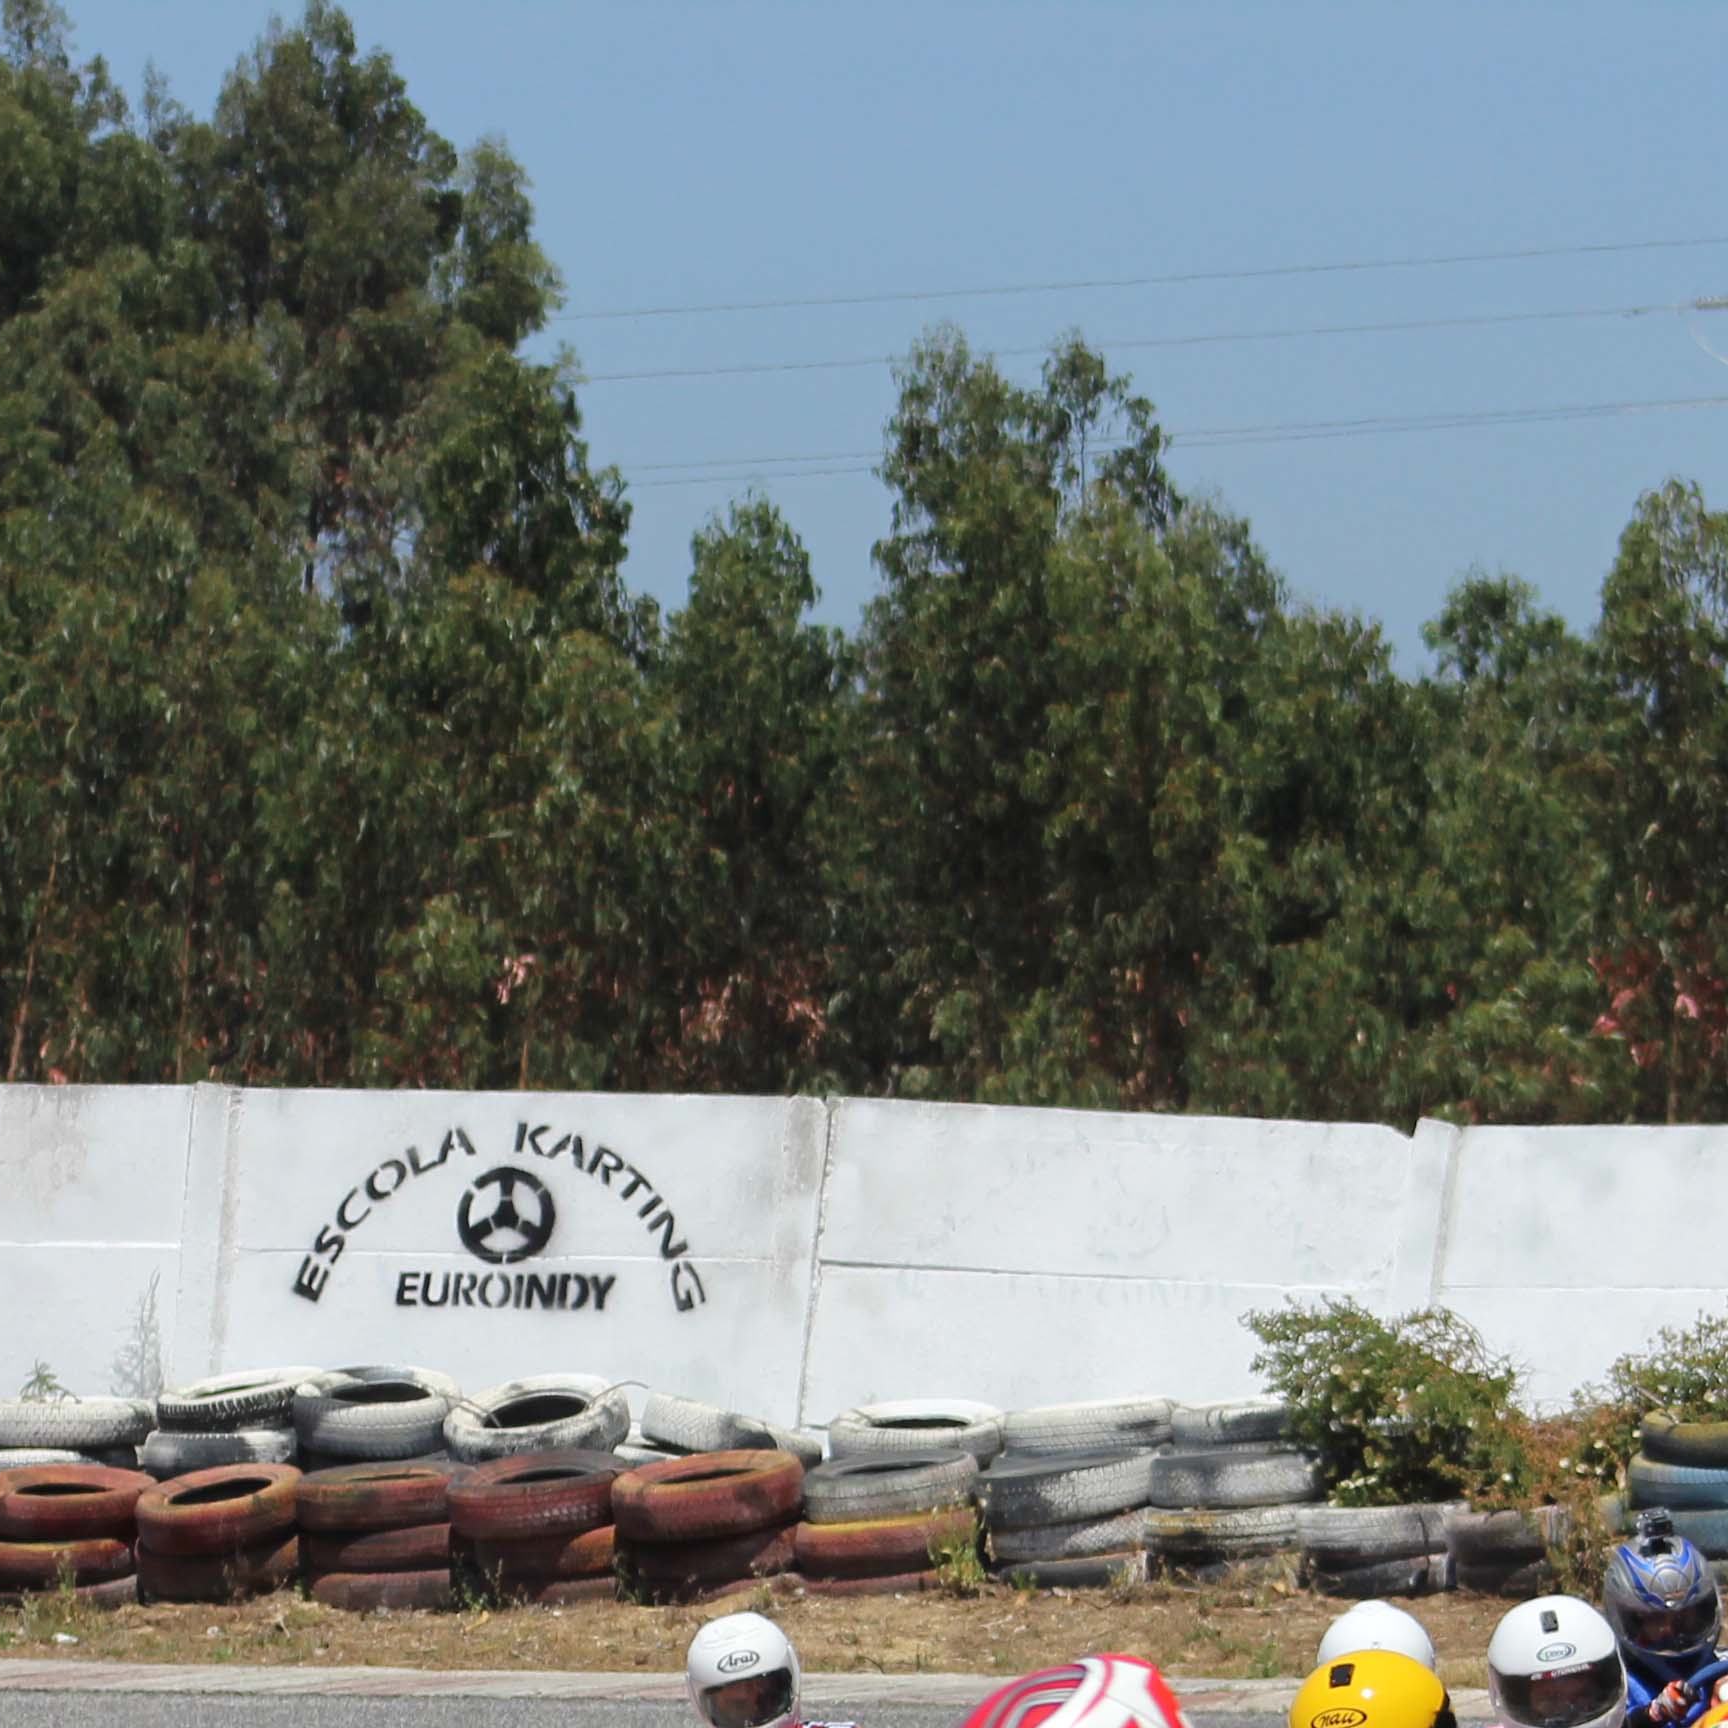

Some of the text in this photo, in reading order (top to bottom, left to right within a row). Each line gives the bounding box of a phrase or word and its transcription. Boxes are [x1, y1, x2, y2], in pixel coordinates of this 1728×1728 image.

[291, 1121, 706, 1313] ESCOLA KARTING
[395, 1271, 616, 1310] EUROINDY
